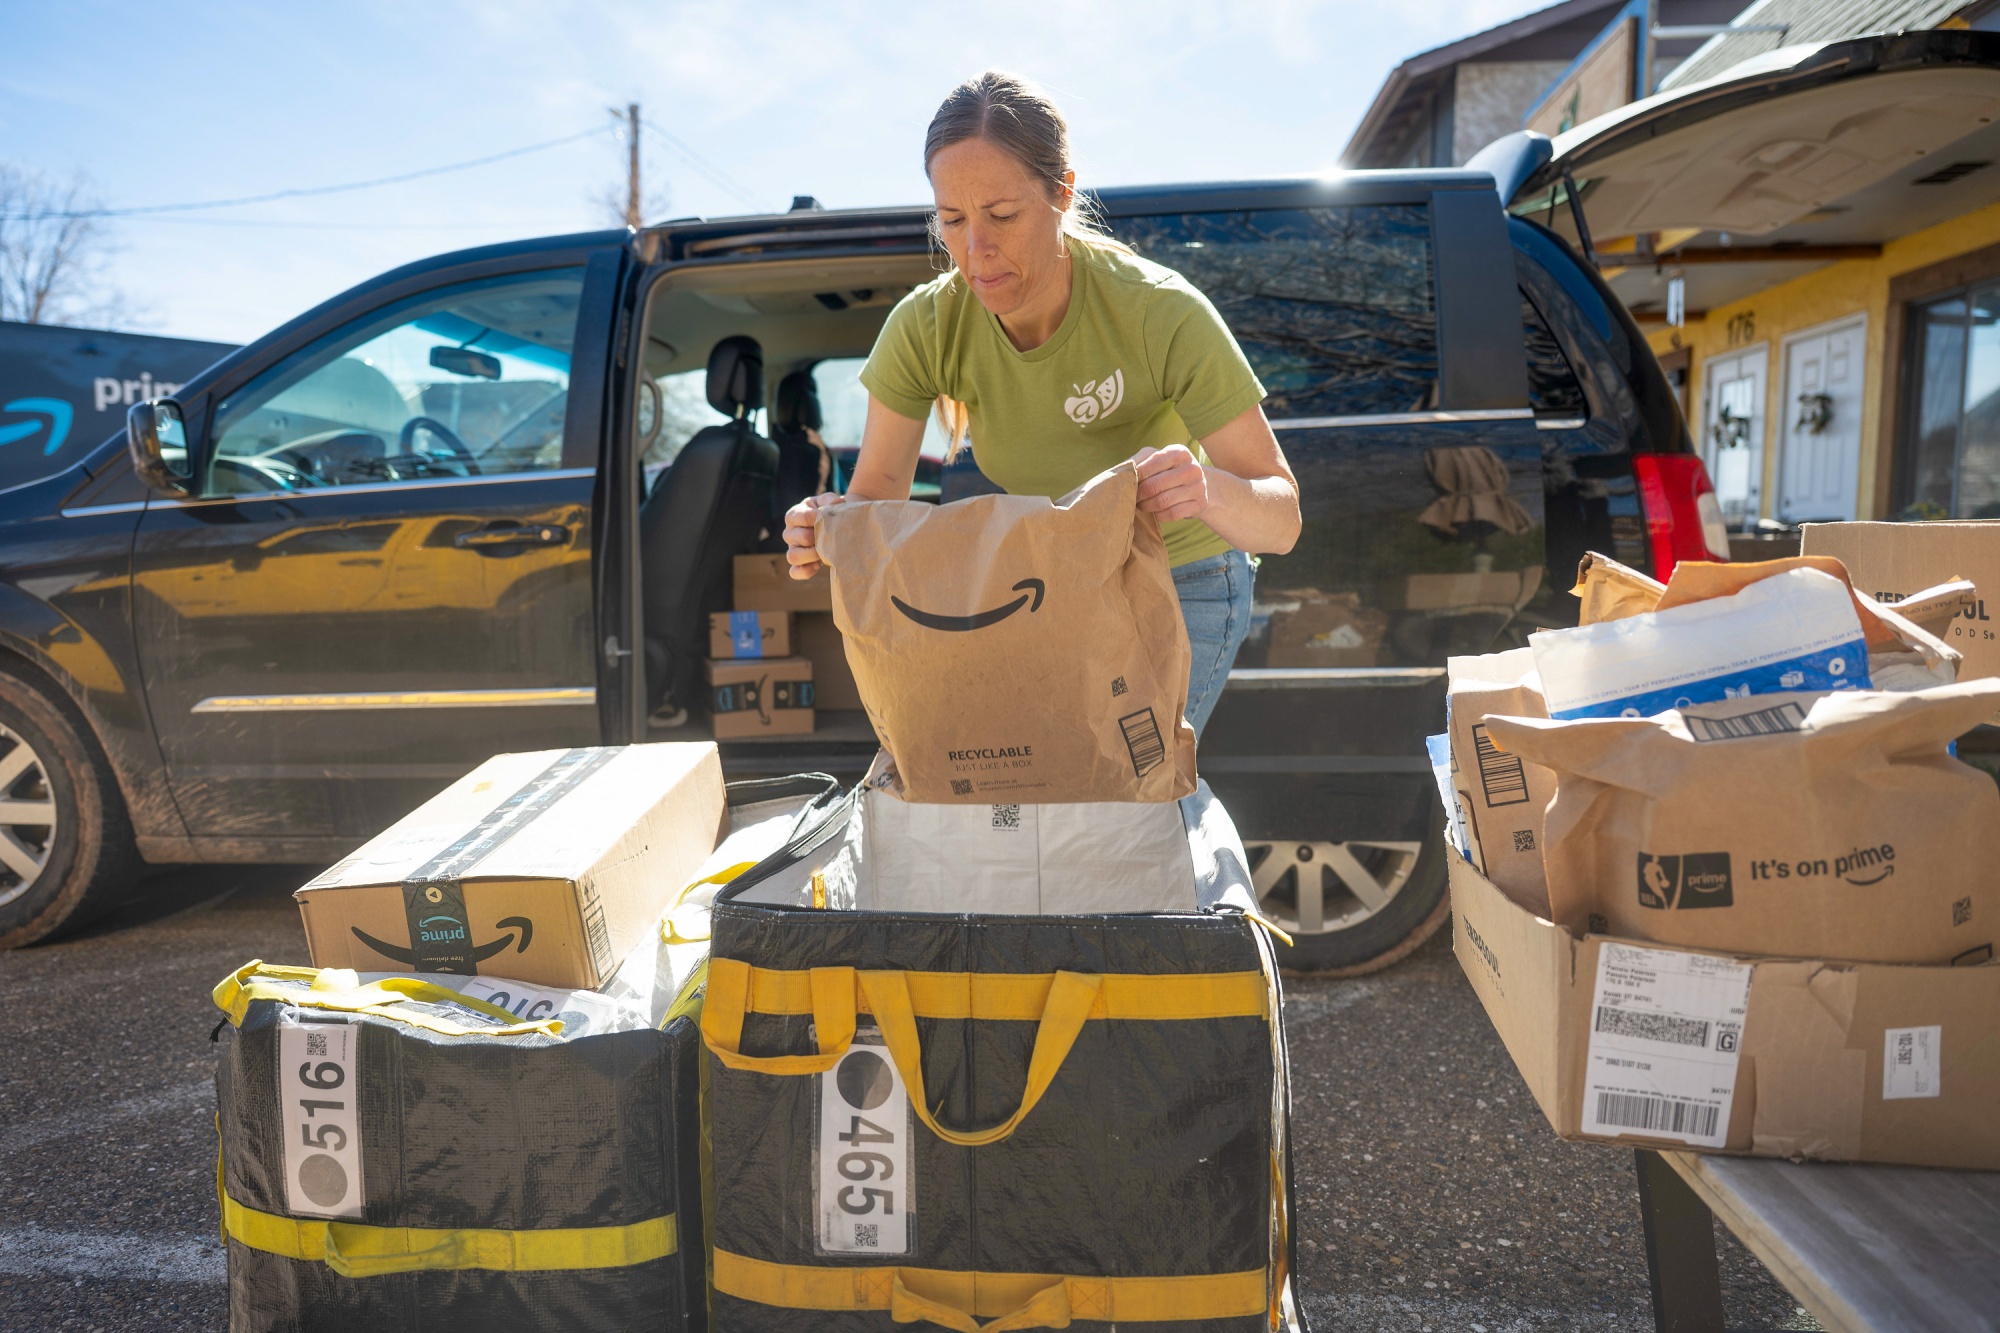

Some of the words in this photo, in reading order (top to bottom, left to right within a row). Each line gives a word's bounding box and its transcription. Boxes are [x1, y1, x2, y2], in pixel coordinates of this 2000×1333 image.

[1726, 310, 1755, 344] 176
[948, 745, 1033, 761] RECYCLABLE
[955, 763, 977, 772] JUST
[979, 761, 999, 771] LIKE
[1003, 760, 1010, 769] A
[1012, 759, 1033, 768] BOX
[1751, 858, 1790, 880] It's
[1796, 860, 1828, 877] on
[1834, 843, 1896, 878] prime
[1688, 872, 1727, 887] prime
[421, 925, 465, 943] prime
[1720, 1034, 1734, 1050] G
[299, 1061, 347, 1152] 516
[837, 1115, 895, 1217] 465
